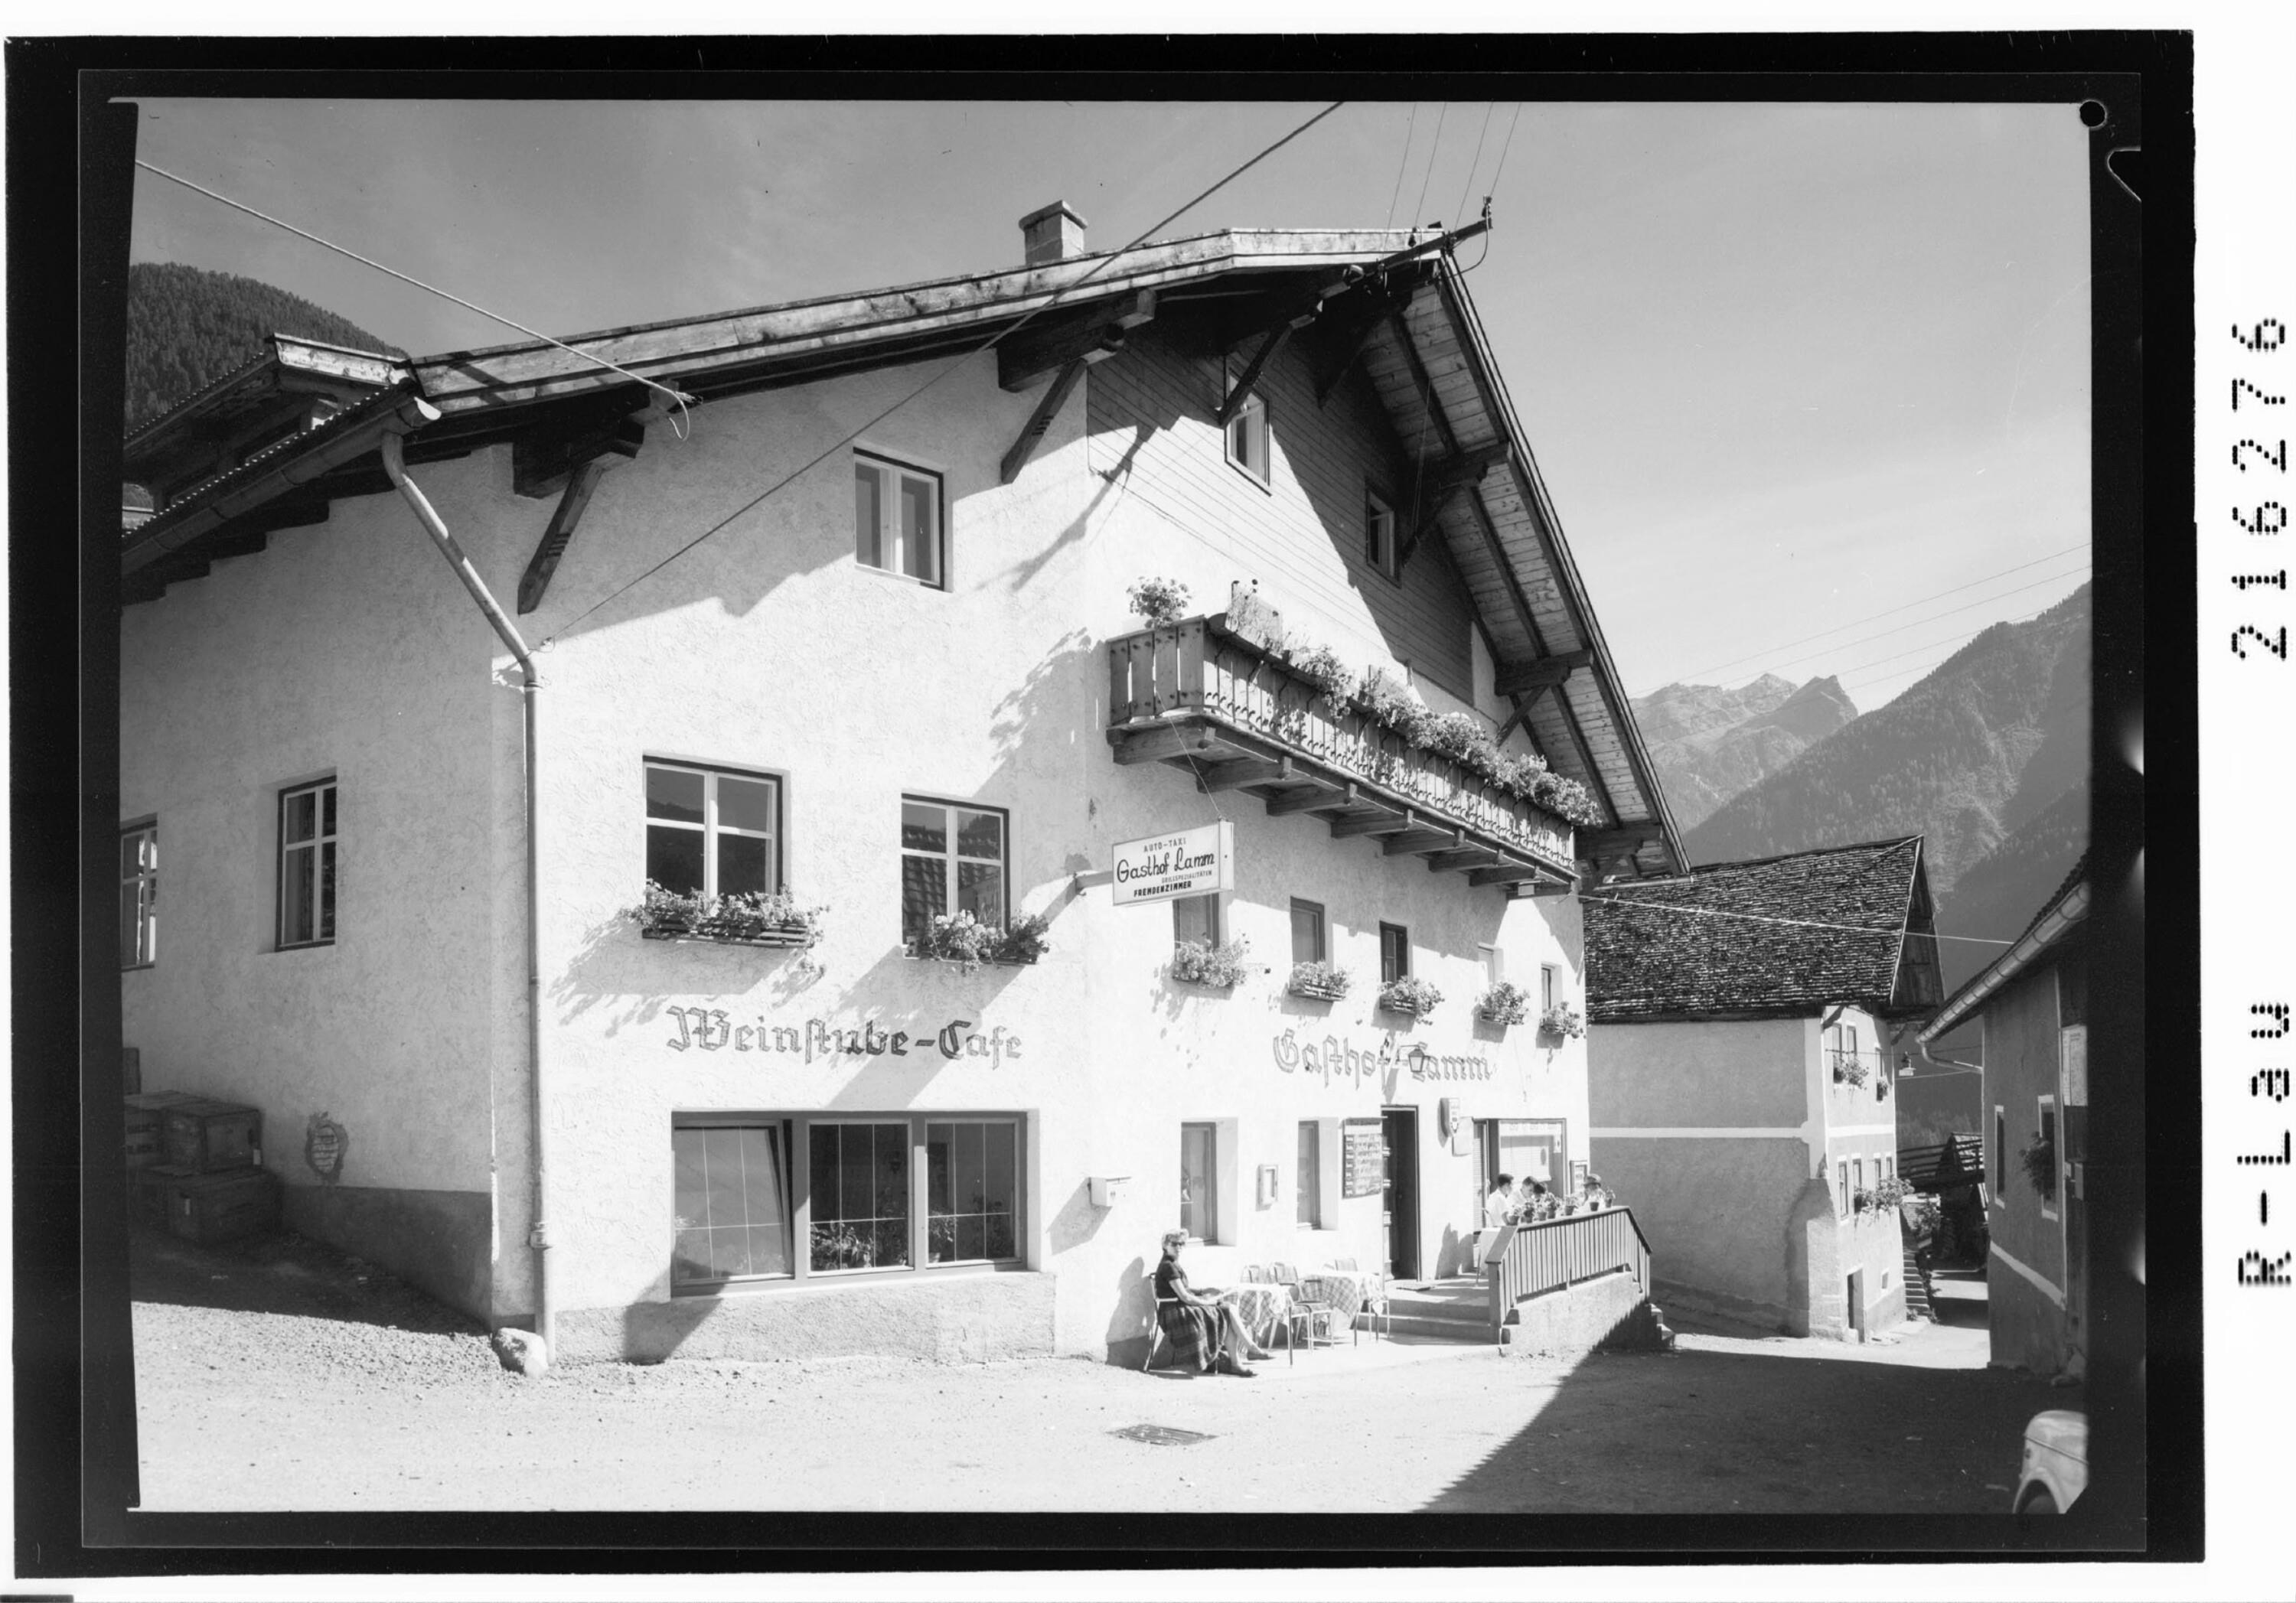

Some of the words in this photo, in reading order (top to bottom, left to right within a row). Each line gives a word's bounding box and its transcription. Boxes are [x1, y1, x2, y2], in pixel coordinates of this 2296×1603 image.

[1143, 837, 1186, 852] AUTO-TAXI
[1117, 852, 1169, 883] Gasthof
[1173, 846, 1215, 872] Lamm
[1133, 881, 1192, 898] FREMDENZIMMER
